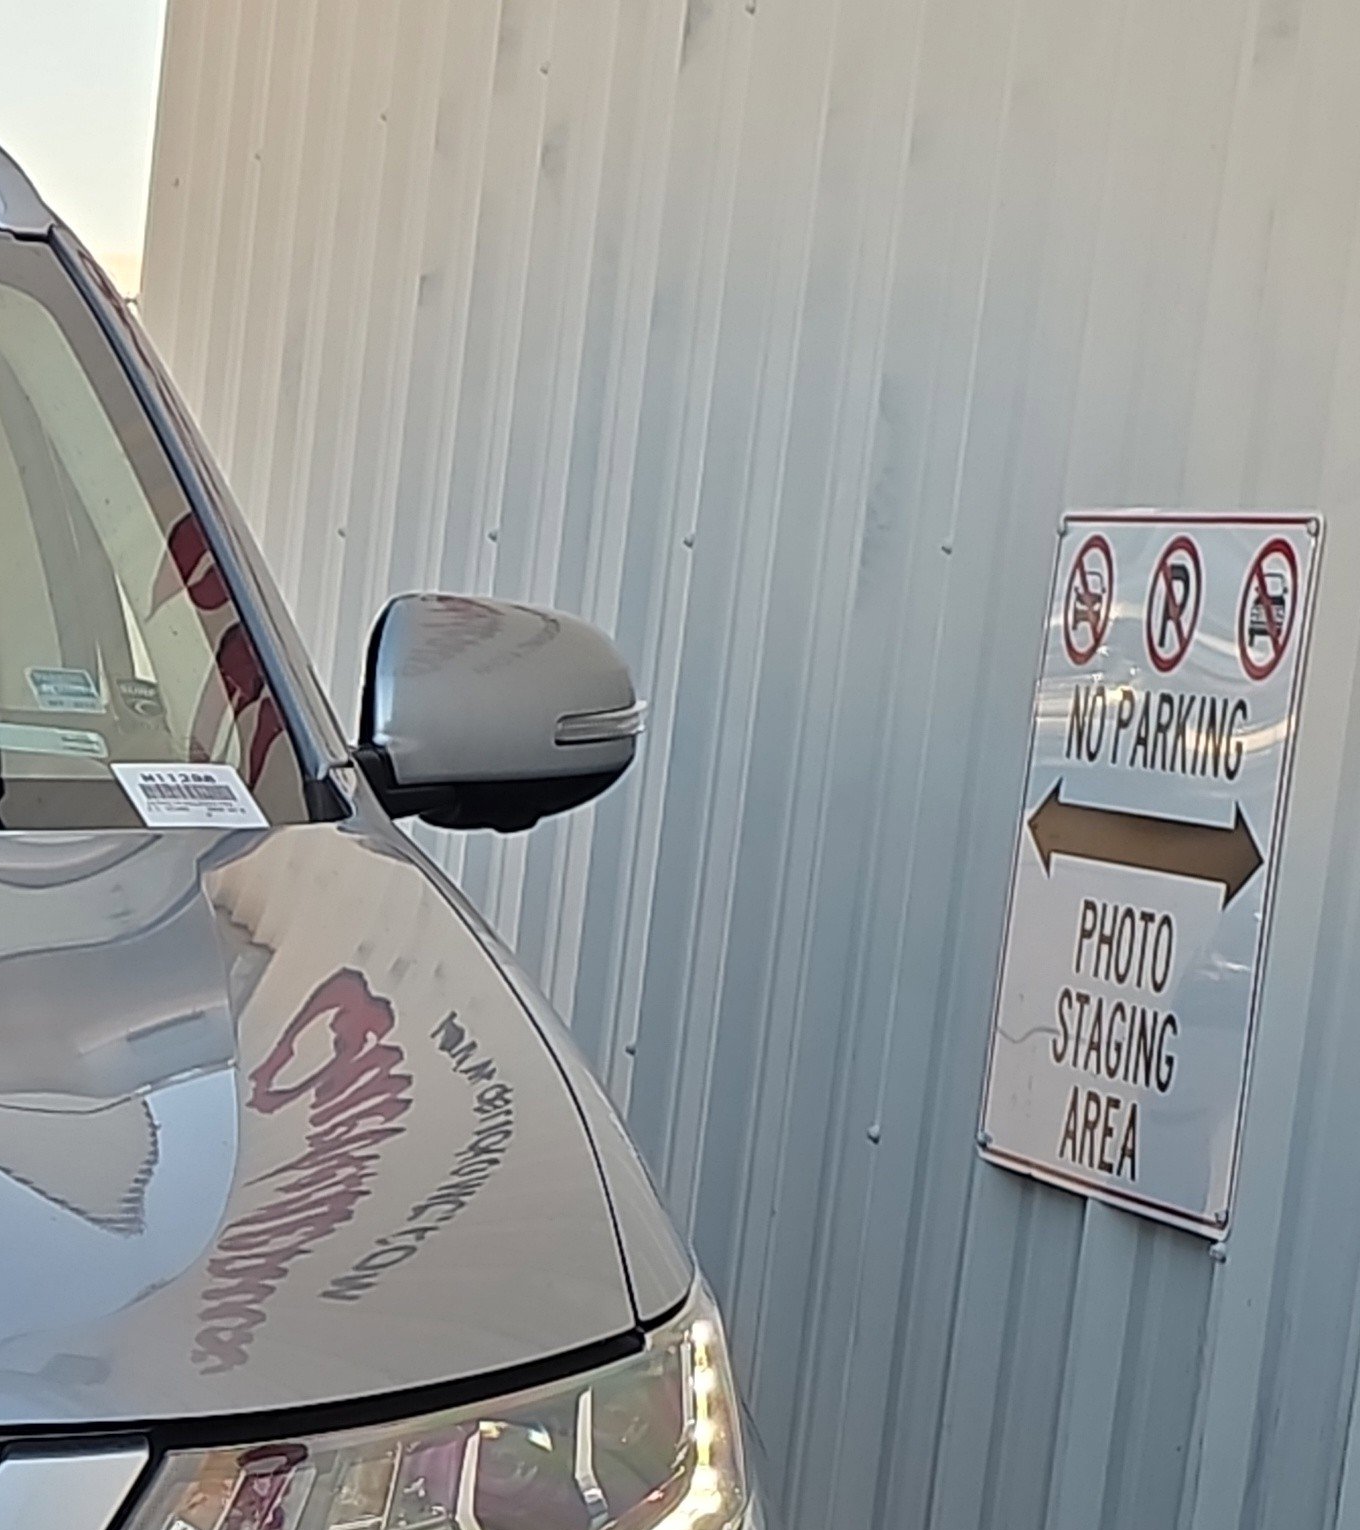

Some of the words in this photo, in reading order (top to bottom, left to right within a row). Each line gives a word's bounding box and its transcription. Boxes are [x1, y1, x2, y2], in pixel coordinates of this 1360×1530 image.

[1065, 685, 1107, 762] NO
[1110, 690, 1248, 780] PARKING
[1075, 900, 1173, 992] PHOTO
[1052, 988, 1177, 1092] STAGING
[1059, 1086, 1137, 1181] AREA
